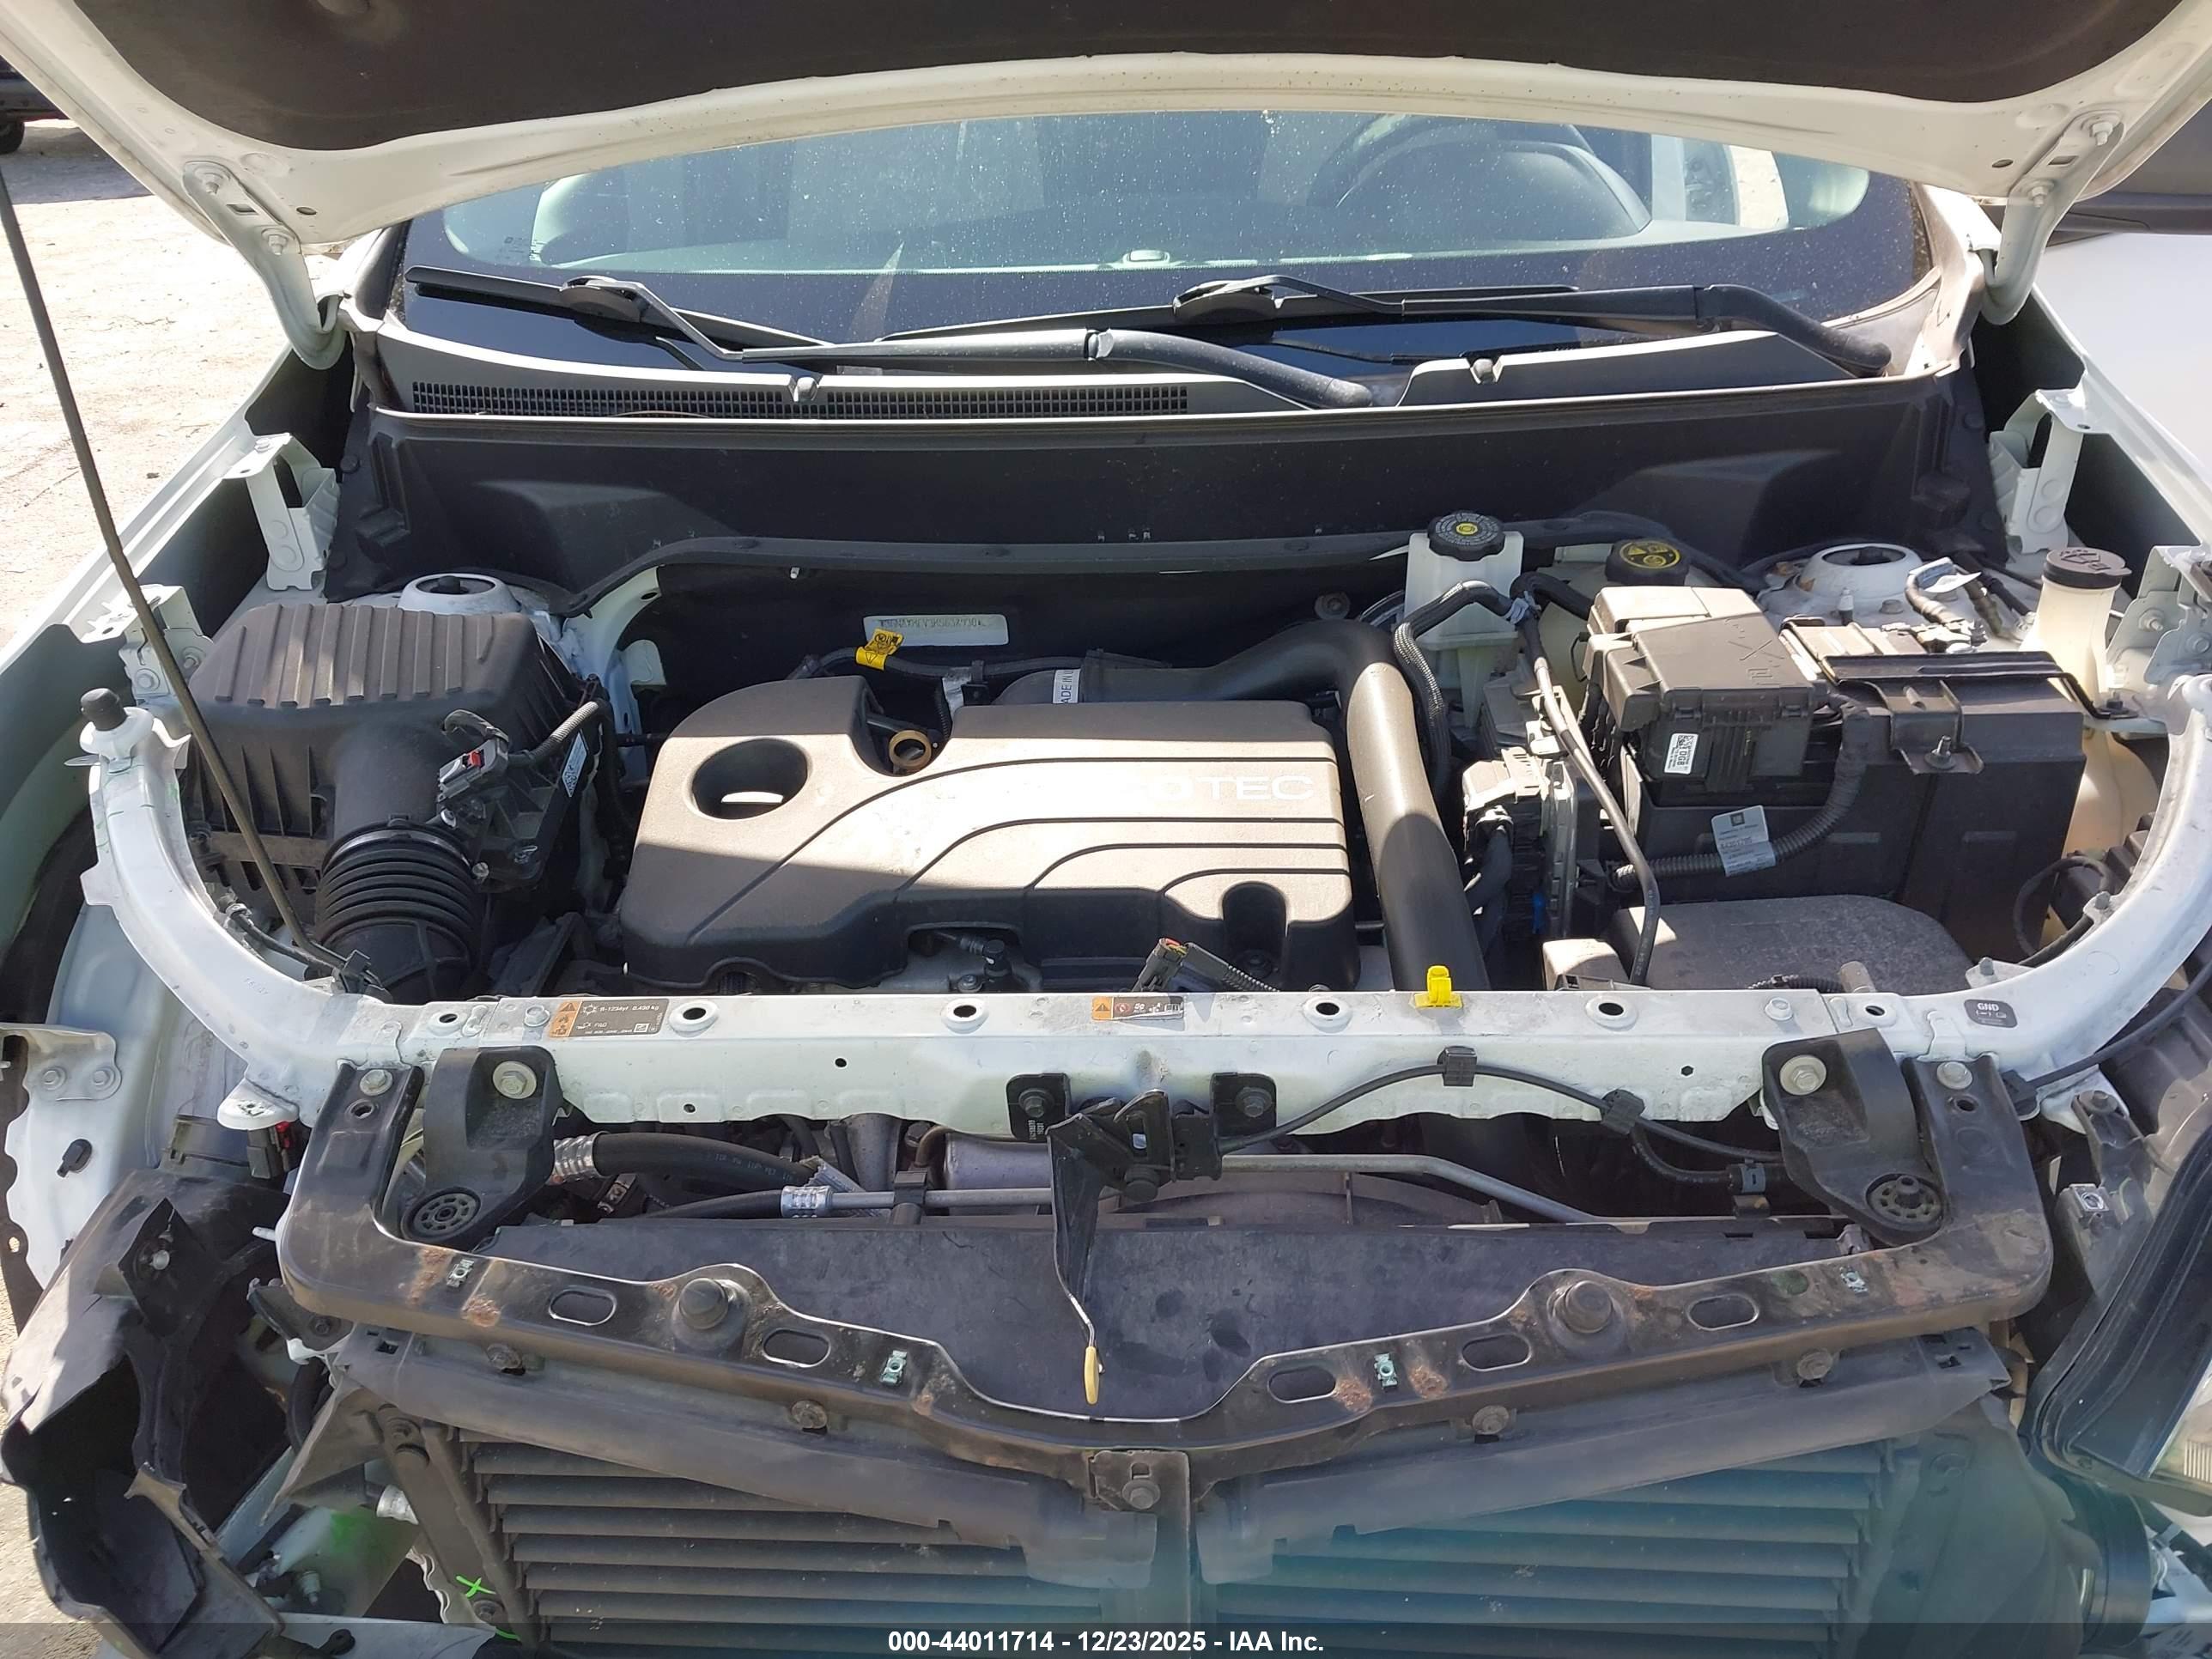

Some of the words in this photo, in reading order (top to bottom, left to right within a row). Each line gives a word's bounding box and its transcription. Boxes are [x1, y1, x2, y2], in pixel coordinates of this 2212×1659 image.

[1060, 685, 1073, 703] ADE
[1148, 775, 1314, 800] OTEC
[1977, 1002, 2000, 1012] GND
